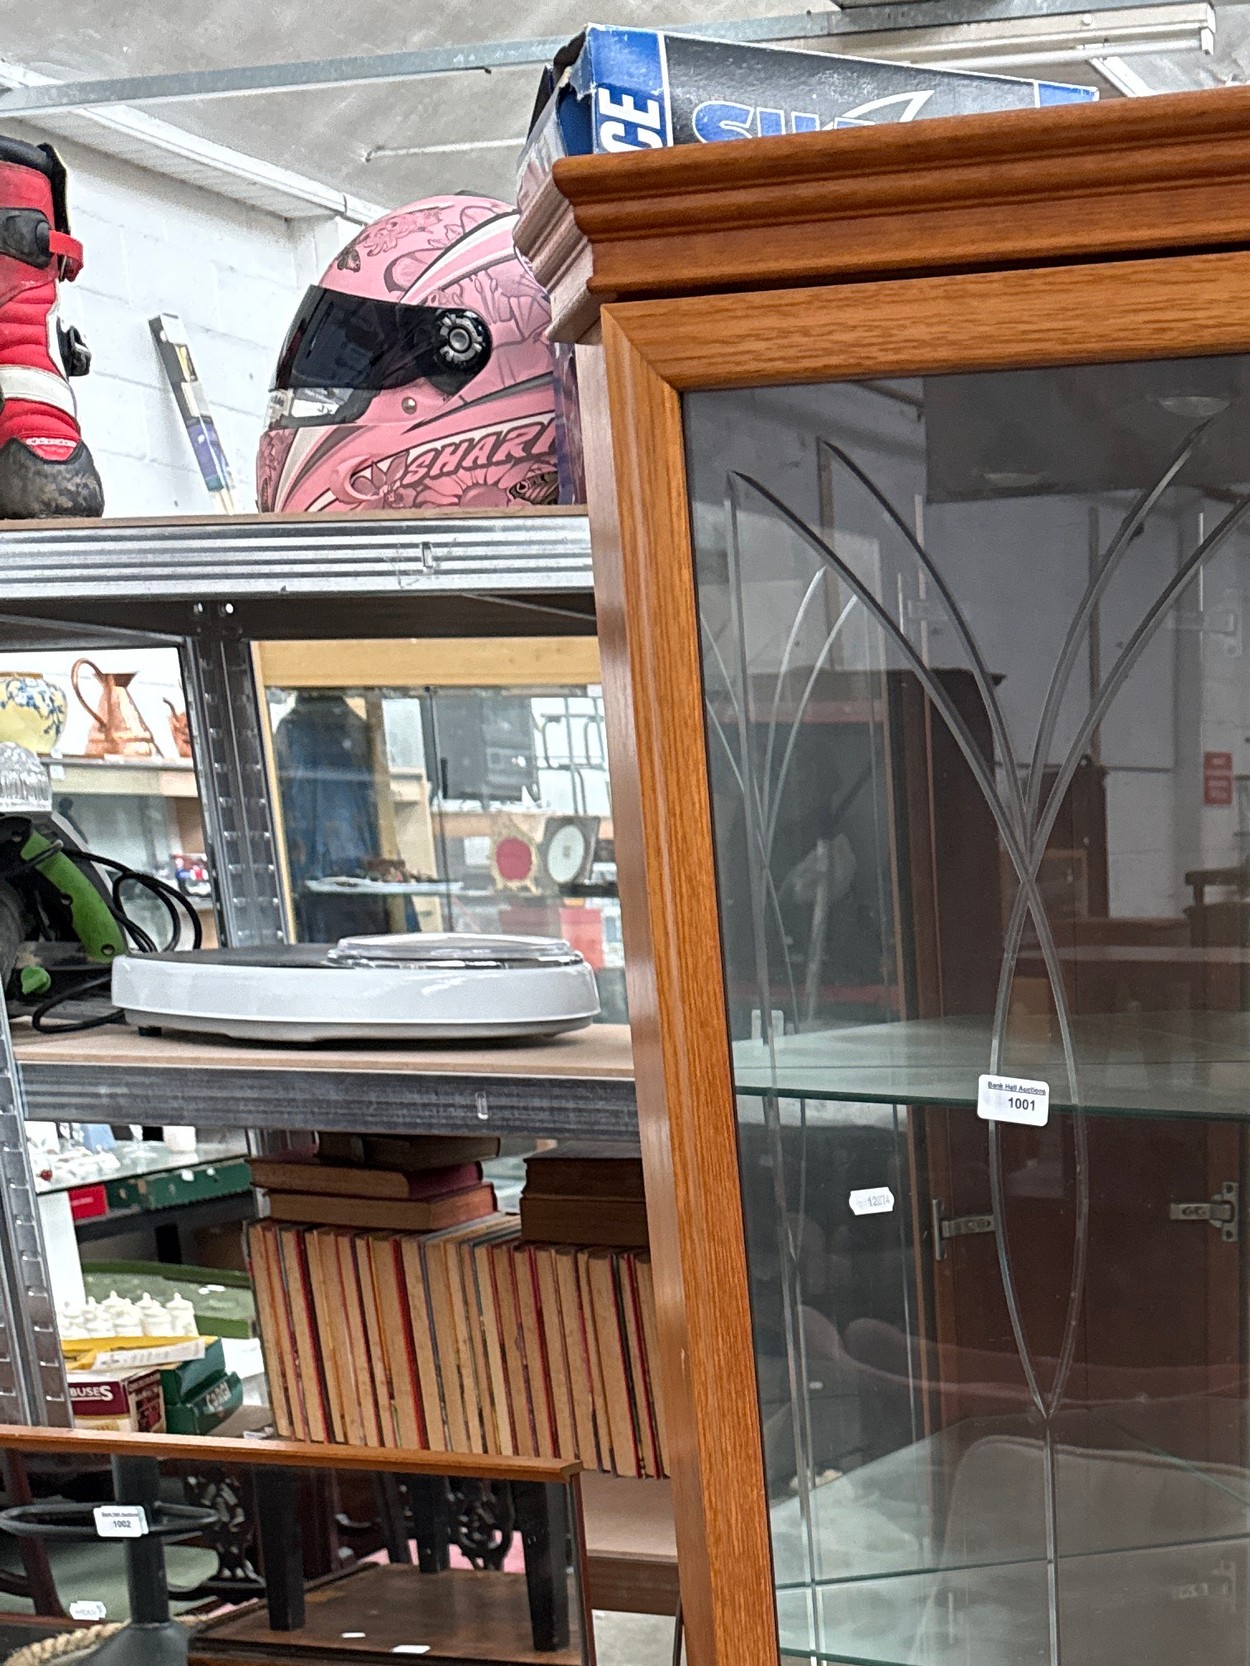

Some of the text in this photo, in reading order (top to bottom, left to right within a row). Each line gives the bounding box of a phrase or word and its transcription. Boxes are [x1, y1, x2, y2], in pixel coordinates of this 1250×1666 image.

[988, 1081, 1047, 1095] Bank Hall Auctions
[1008, 1097, 1036, 1111] 1001
[69, 1385, 114, 1401] BUSES
